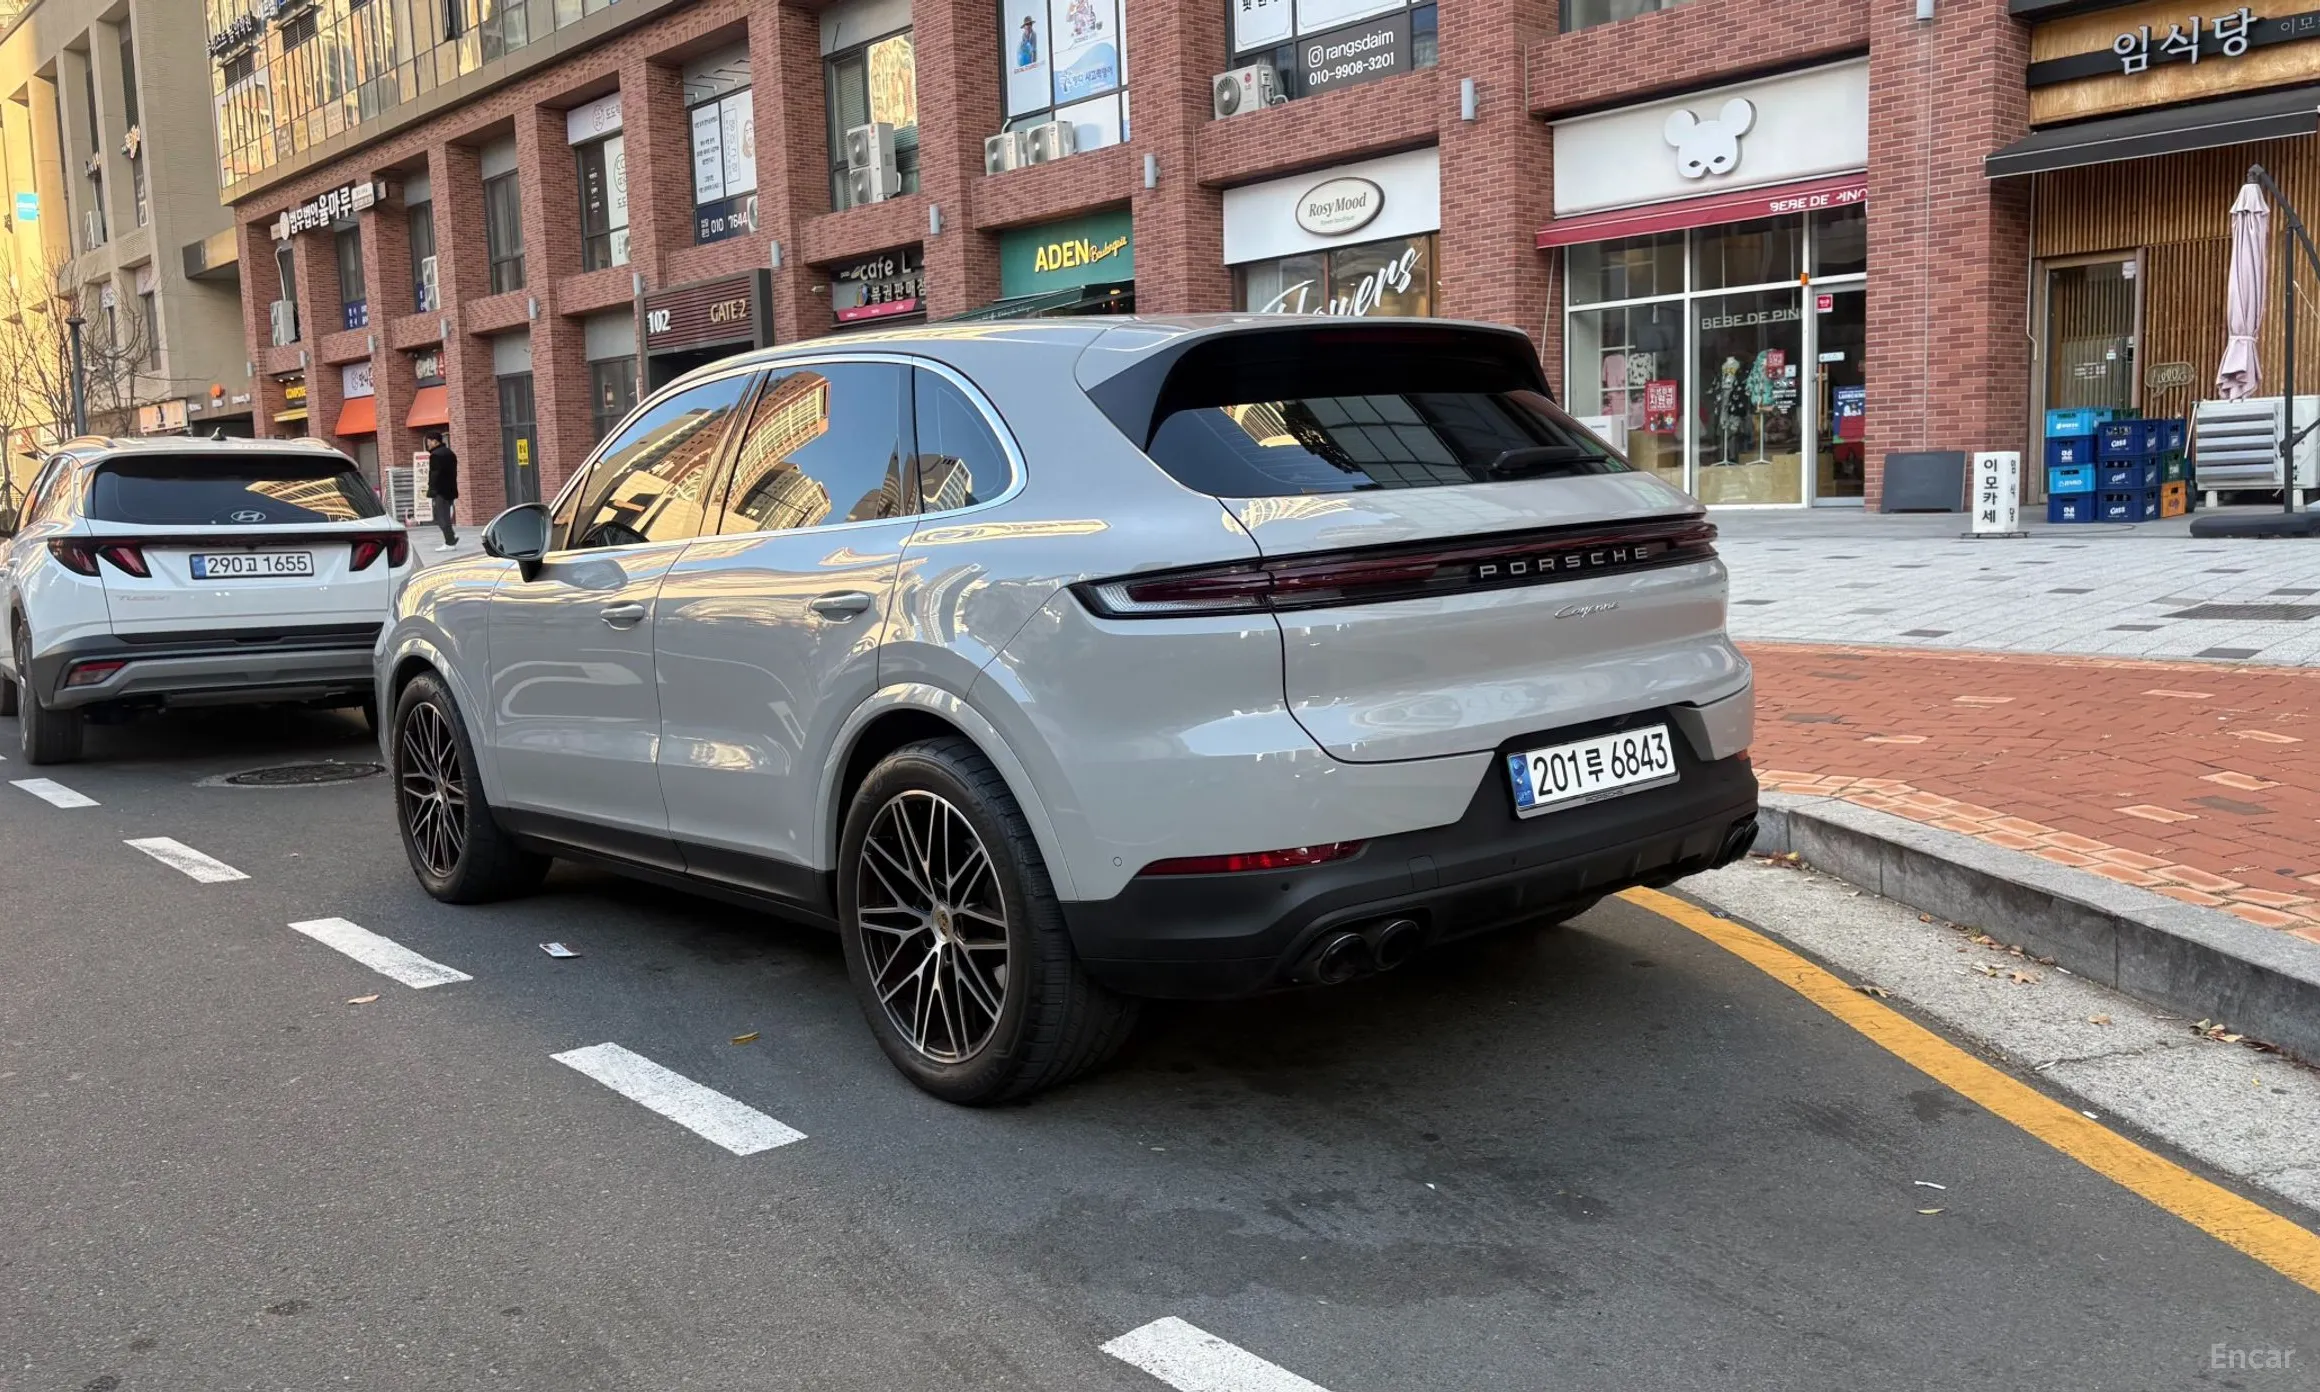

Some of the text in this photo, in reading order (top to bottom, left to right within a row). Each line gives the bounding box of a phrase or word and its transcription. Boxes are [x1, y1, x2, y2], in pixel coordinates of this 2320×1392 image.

[1326, 30, 1394, 60] rangsdaim
[2113, 7, 2320, 75] 임식당 이모
[1309, 52, 1395, 86] 010-9908-3201
[288, 201, 319, 234] 법무법인
[318, 186, 352, 228] 율마루
[1308, 192, 1367, 218] Rosy Mood
[1809, 194, 1830, 207] DE
[710, 217, 724, 233] 010
[860, 256, 893, 280] cafe
[1034, 238, 1090, 273] ADEN
[871, 278, 926, 304] 복권판매점
[647, 309, 672, 333] 102
[710, 299, 747, 323] GATE 2
[1702, 307, 1803, 330] BEBE DE PIN
[1982, 458, 1999, 523] 이모카세
[208, 555, 307, 574] 290고 1655
[1479, 547, 1649, 579] PORSCHE
[1554, 601, 1620, 619] Cayenne
[1533, 732, 1668, 796] 201루 6843
